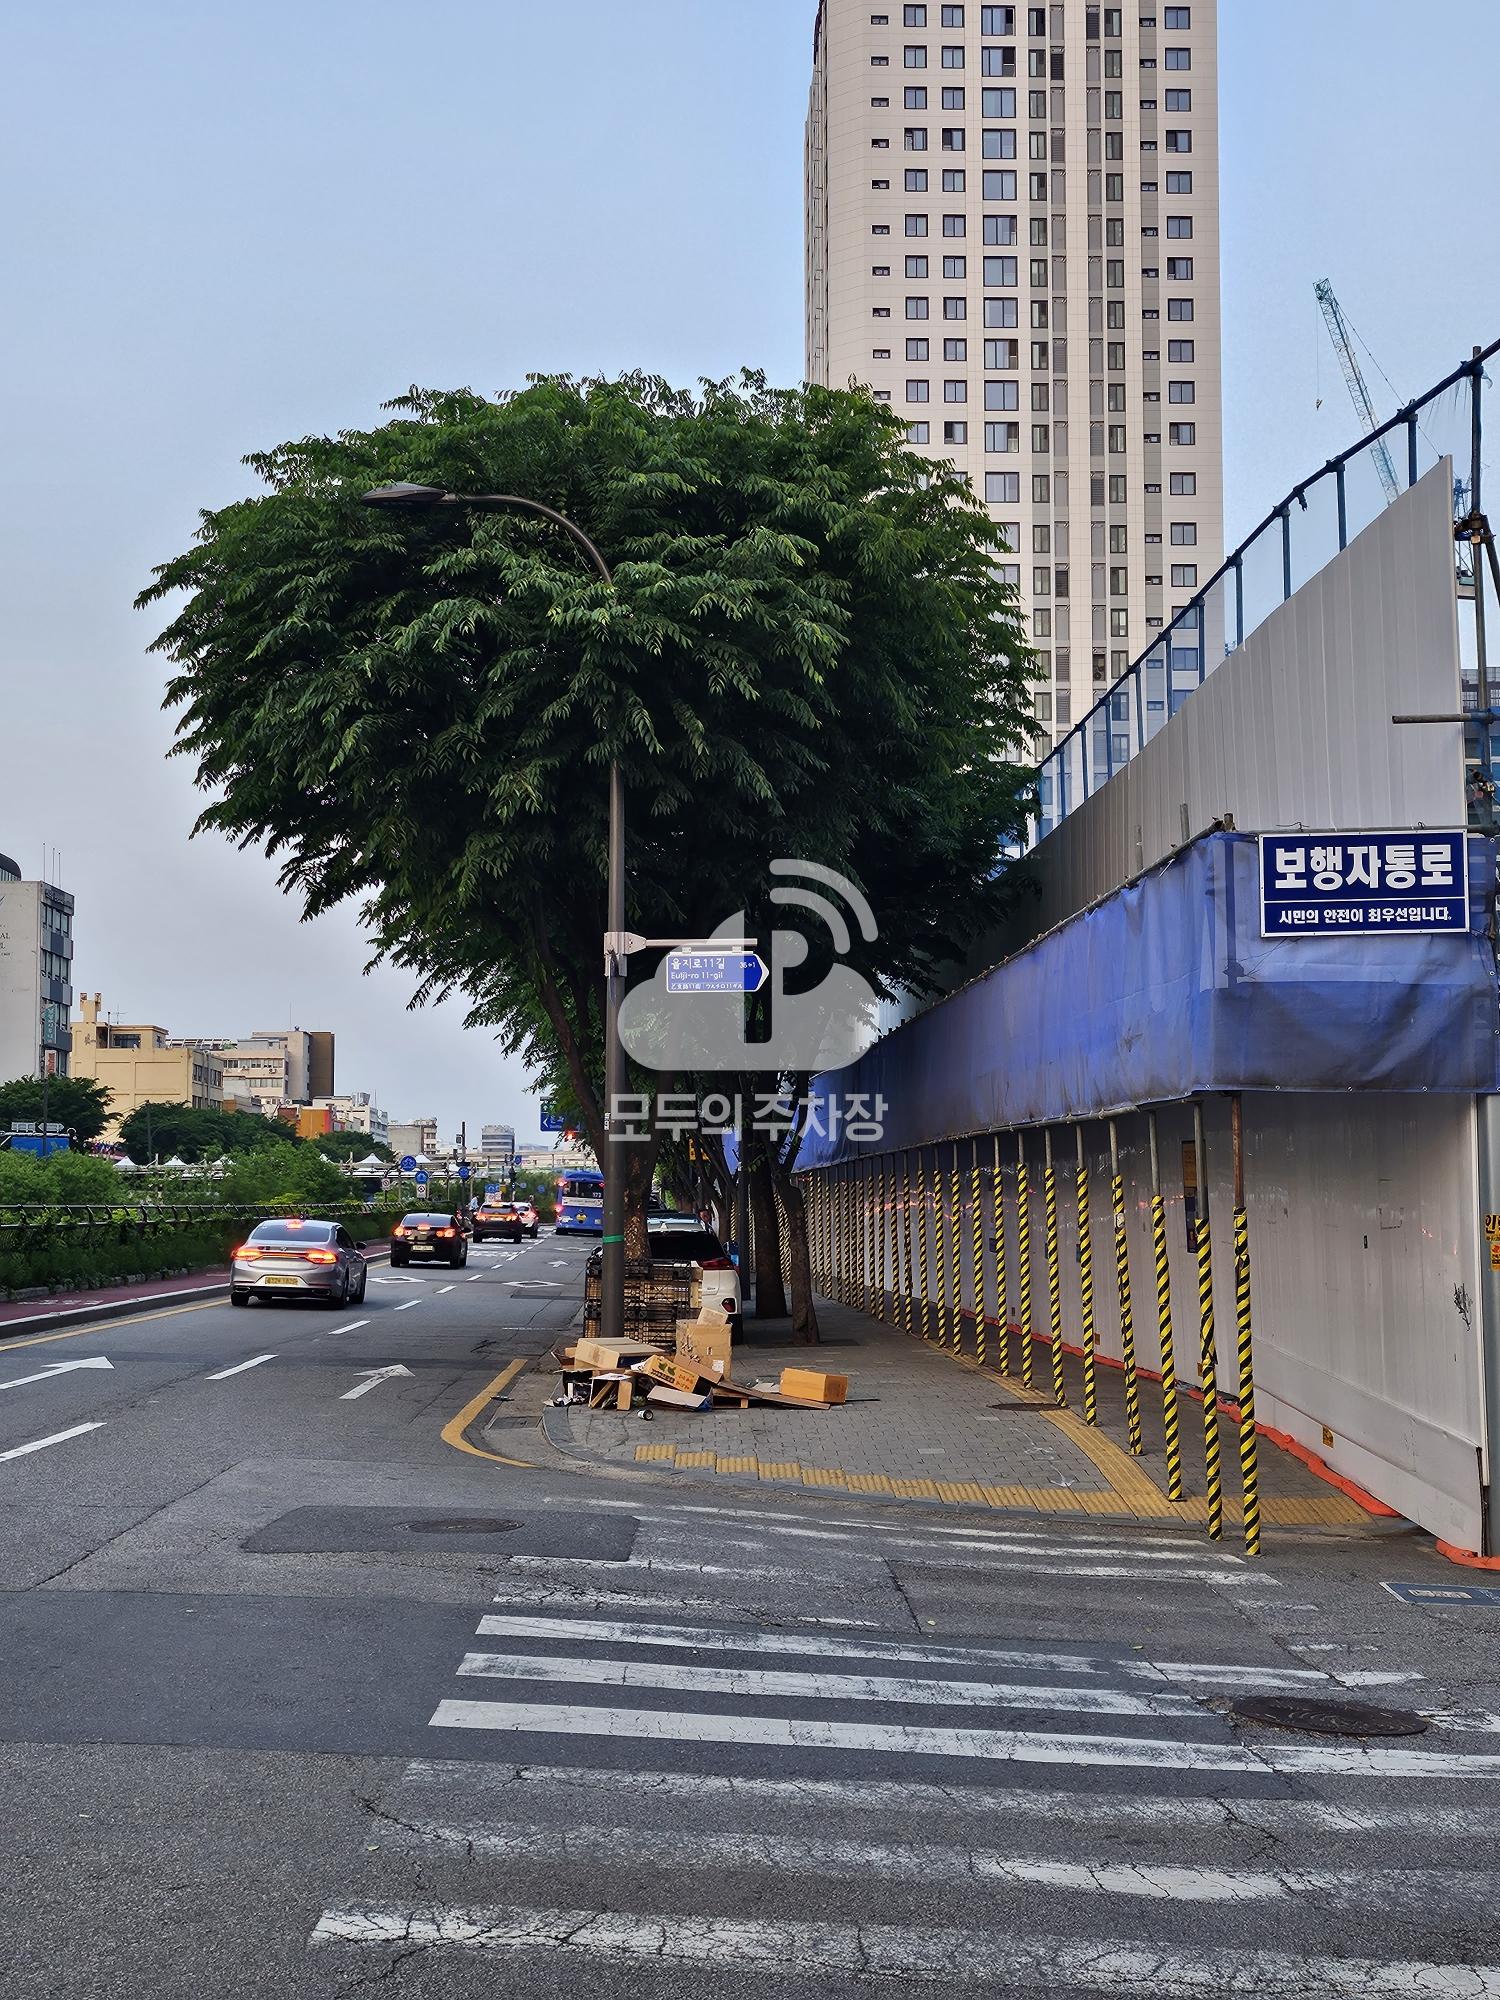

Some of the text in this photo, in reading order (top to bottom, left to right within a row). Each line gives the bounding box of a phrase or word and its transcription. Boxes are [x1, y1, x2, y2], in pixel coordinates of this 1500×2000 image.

[1275, 845, 1454, 891] 보행자통로
[1279, 906, 1452, 925] 시민의 안전이 최우선입니다.
[671, 957, 725, 970] 을지로11길
[671, 971, 723, 981] Eulji-ro 11-gil
